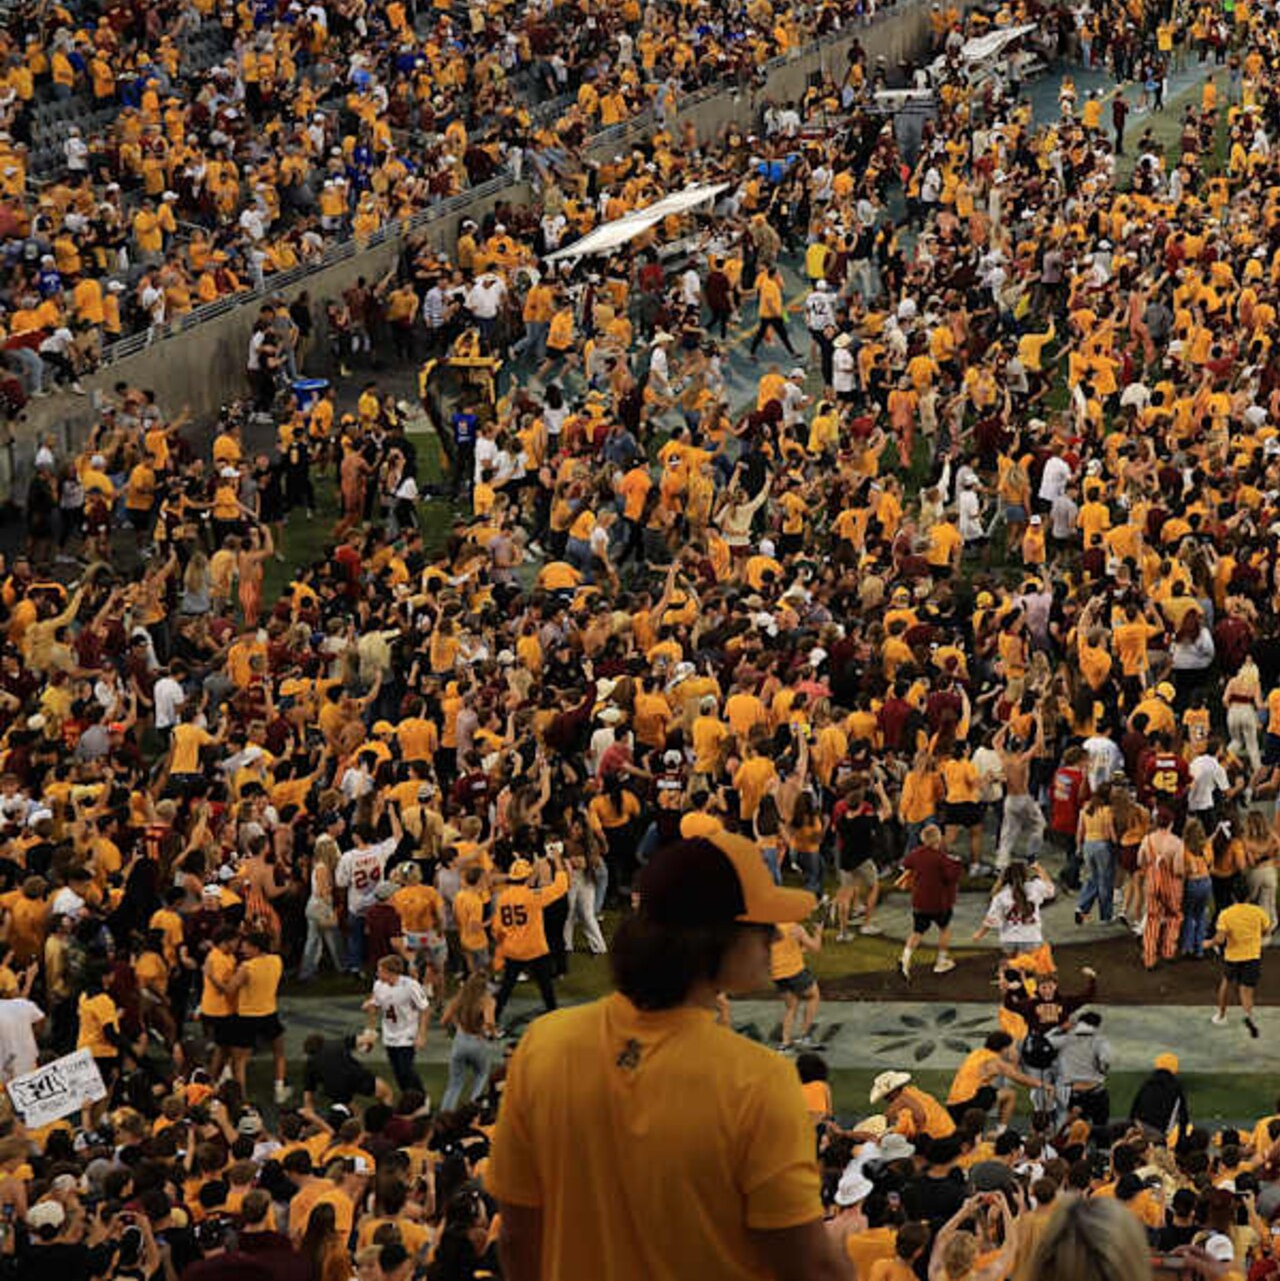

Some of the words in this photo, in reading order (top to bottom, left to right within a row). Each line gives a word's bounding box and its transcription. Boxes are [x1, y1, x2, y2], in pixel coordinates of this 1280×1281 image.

[1152, 769, 1179, 793] 42
[500, 904, 528, 928] 85
[385, 1004, 398, 1024] 4
